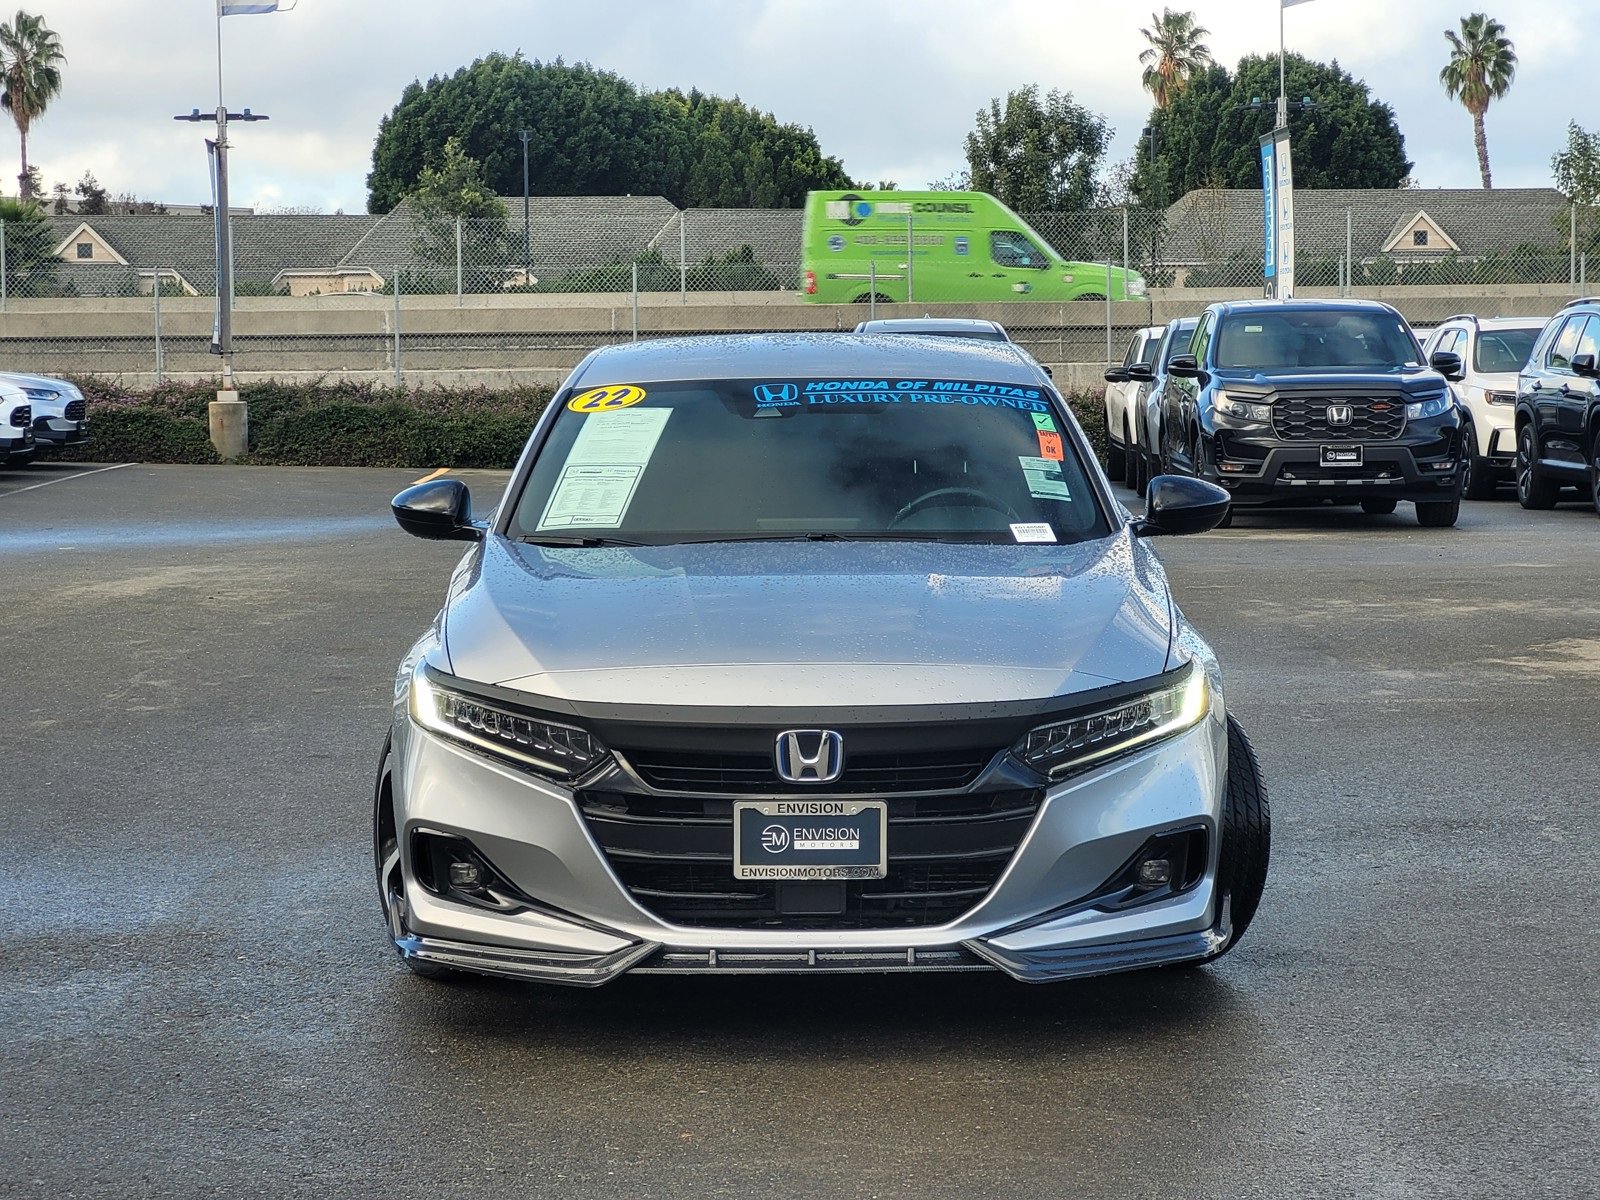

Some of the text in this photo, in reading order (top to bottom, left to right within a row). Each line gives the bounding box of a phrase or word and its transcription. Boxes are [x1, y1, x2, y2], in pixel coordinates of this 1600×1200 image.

[805, 381, 1040, 399] HONDA OF MILPITAS
[583, 388, 631, 409] 22
[808, 393, 1048, 412] LUXURY PRE-OWNED
[1045, 445, 1056, 454] OK
[777, 803, 844, 814] ENVISION
[793, 828, 860, 840] ENVISION
[741, 868, 880, 878] ENVISIONMOTORS.COM
